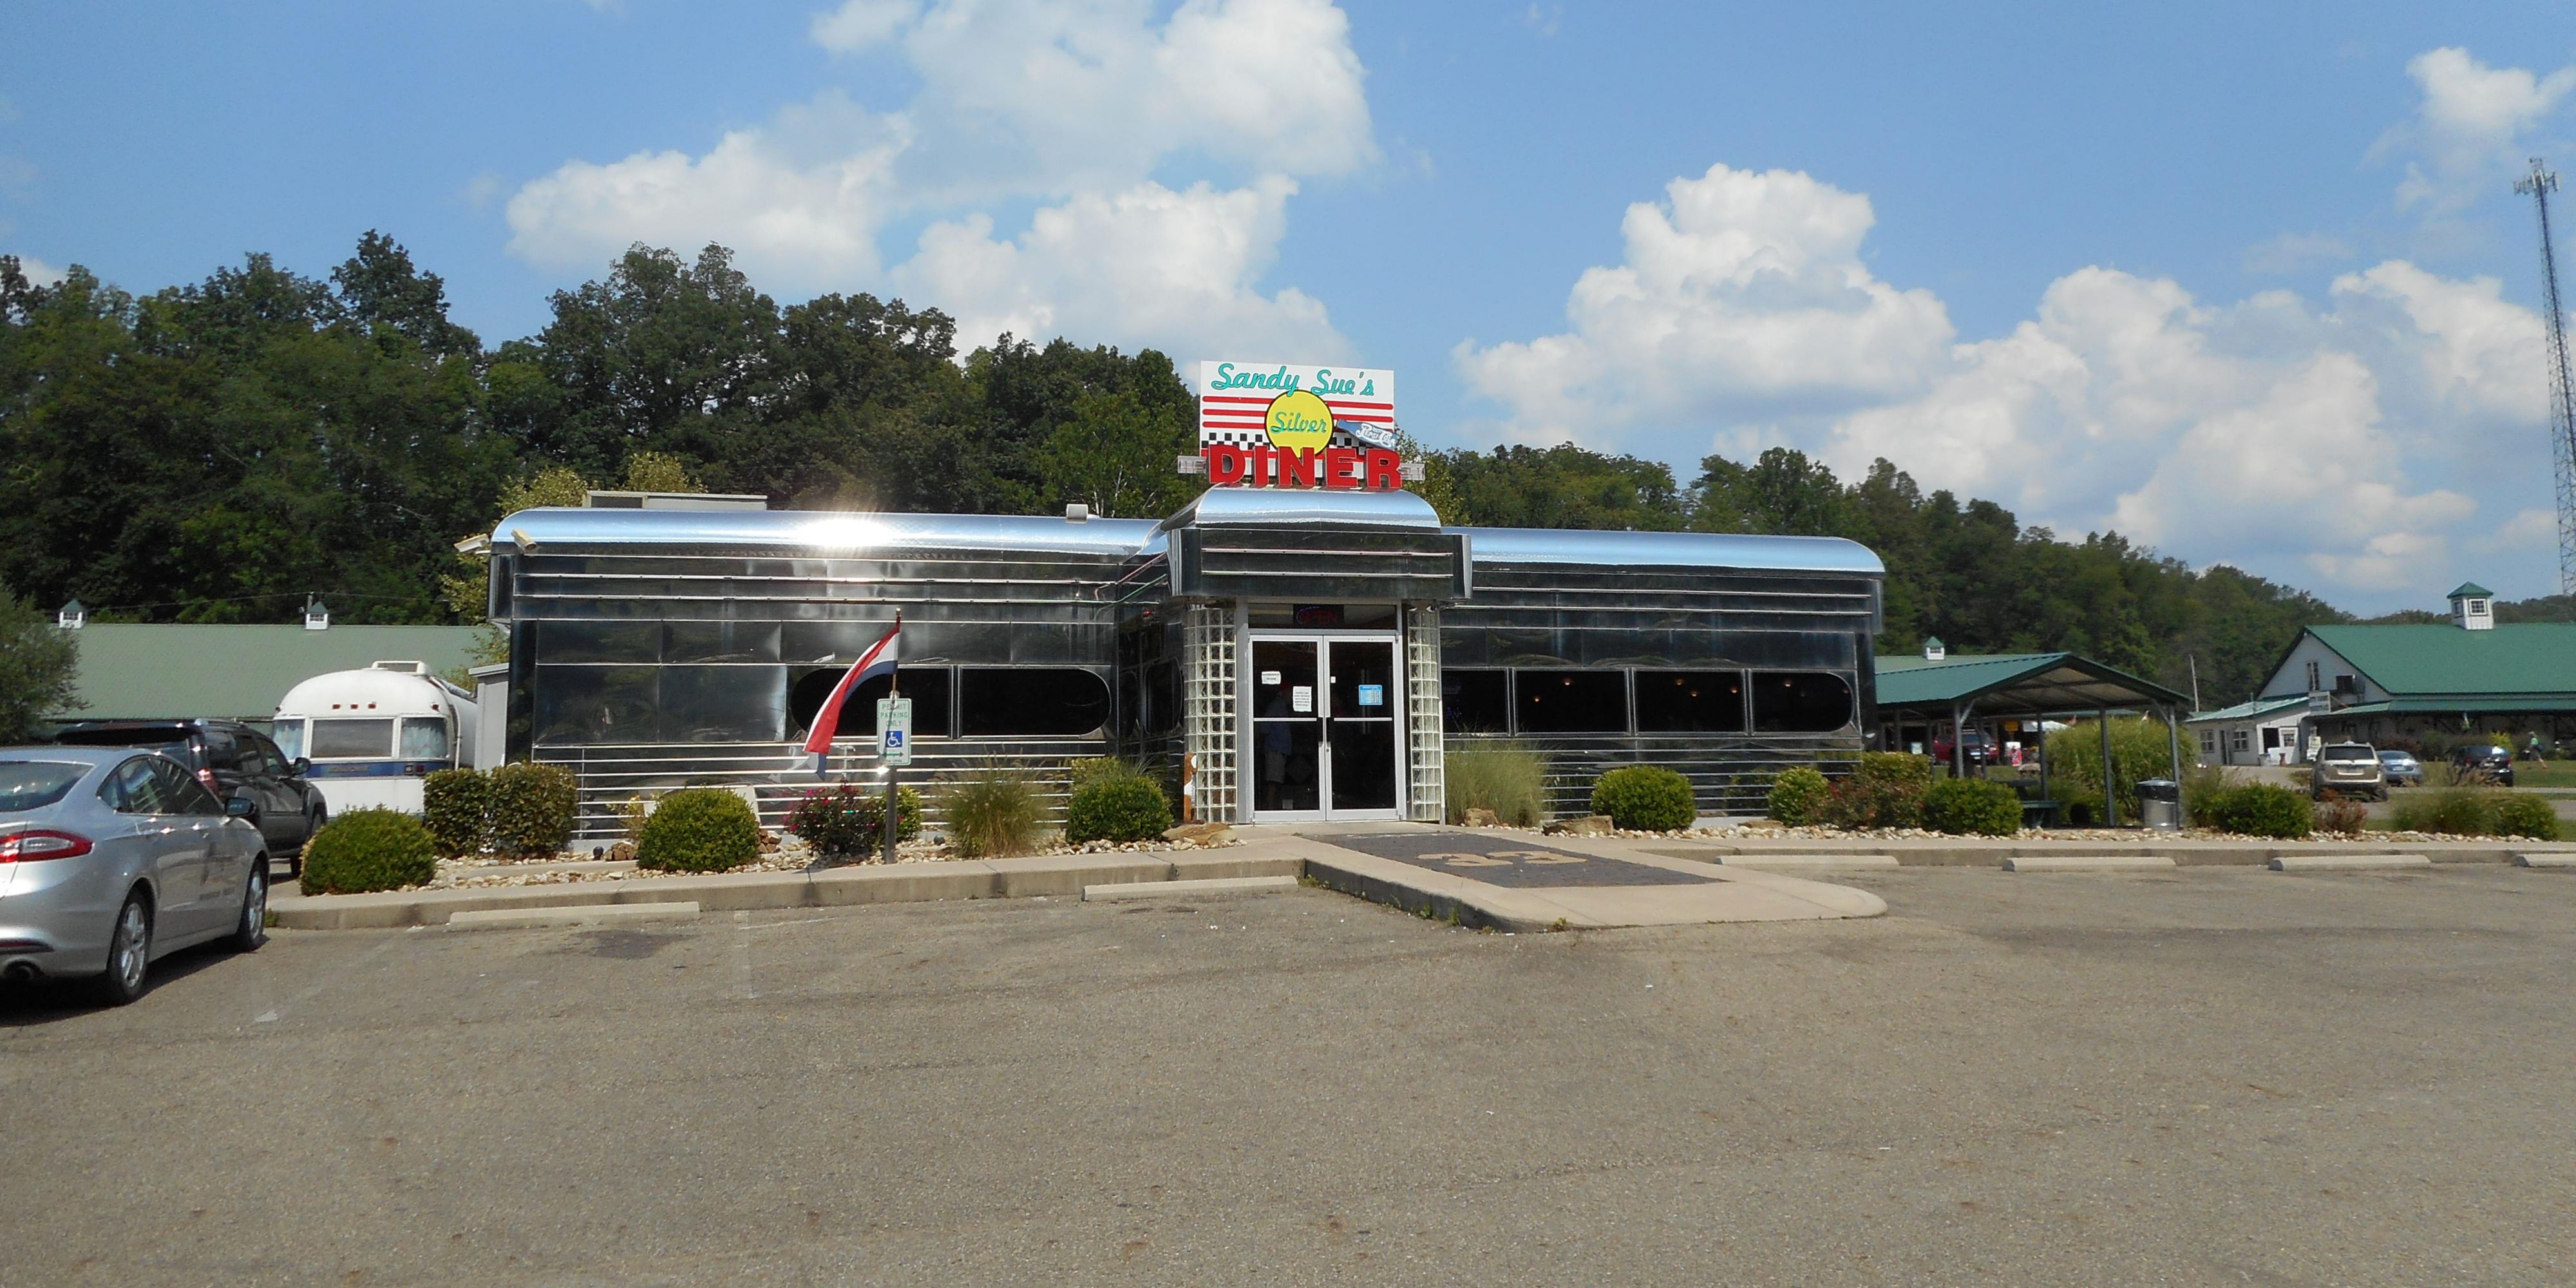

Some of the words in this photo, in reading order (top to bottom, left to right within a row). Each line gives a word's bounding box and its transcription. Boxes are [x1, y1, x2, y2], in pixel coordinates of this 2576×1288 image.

[1211, 363, 1299, 397] Sandy
[1311, 369, 1374, 396] Sue's
[1271, 412, 1327, 433] Silver
[1209, 444, 1403, 488] DINER
